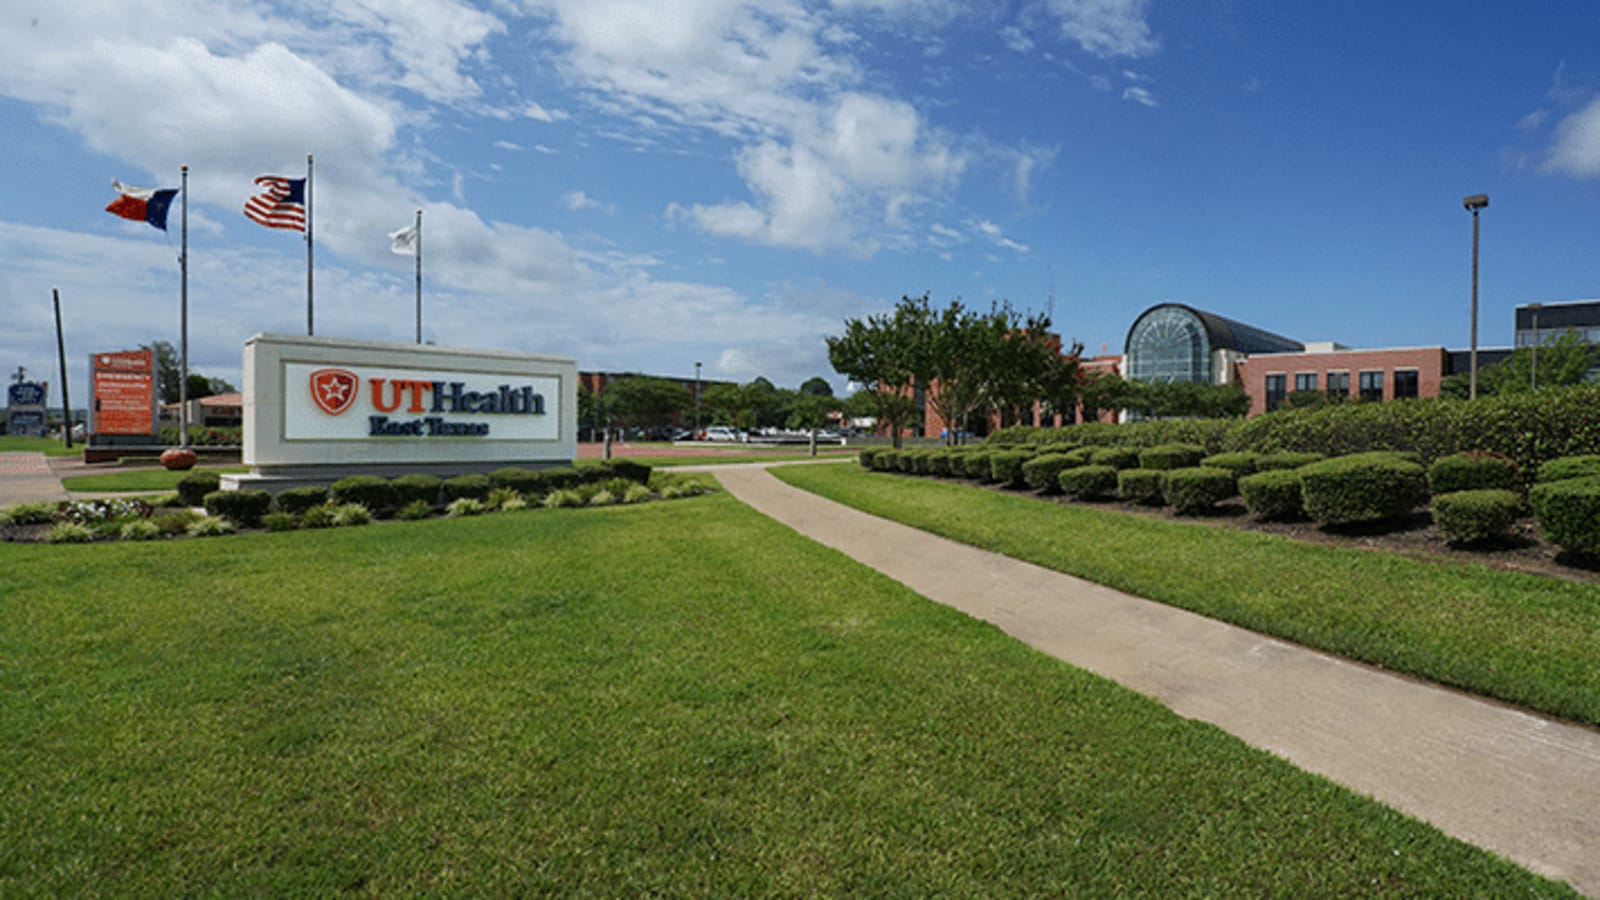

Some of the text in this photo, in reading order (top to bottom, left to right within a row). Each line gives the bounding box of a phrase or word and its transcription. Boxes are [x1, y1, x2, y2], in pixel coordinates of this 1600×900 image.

[368, 377, 546, 415] UTHealth
[368, 416, 490, 437] East Texas
